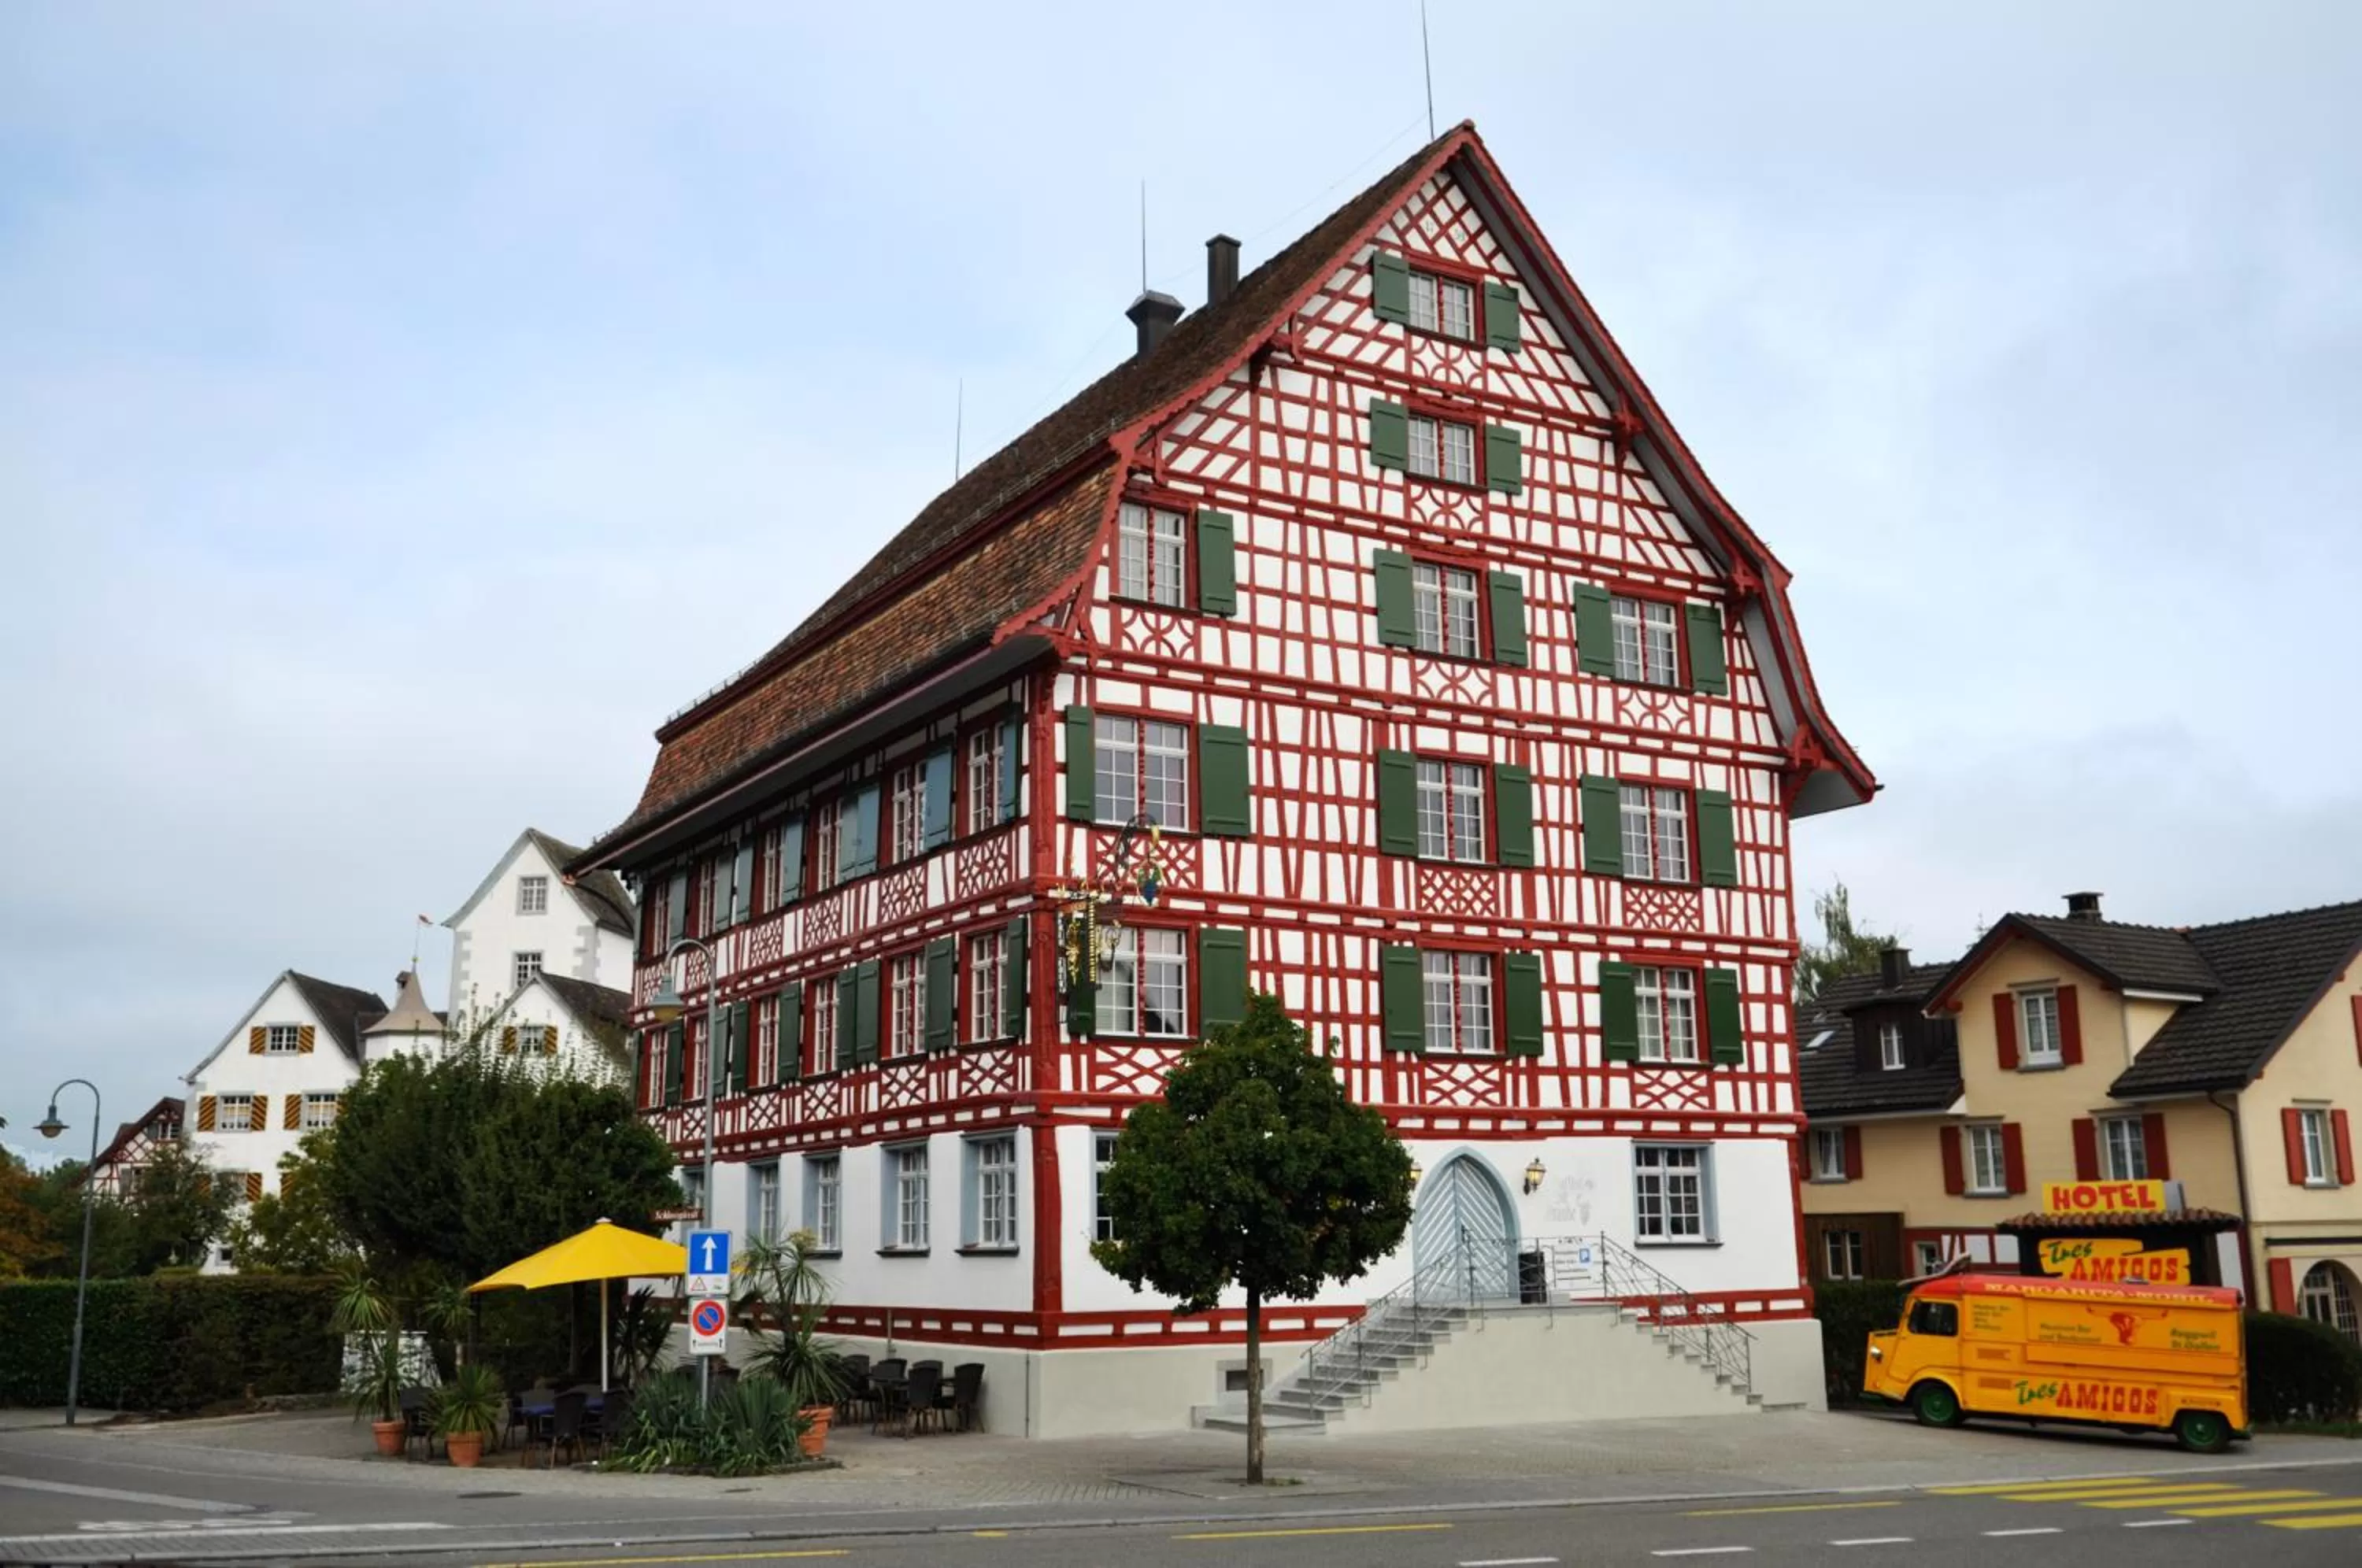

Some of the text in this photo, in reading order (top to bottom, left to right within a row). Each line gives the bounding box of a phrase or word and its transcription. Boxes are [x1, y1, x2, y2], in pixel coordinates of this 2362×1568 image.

[2052, 1184, 2157, 1211] HOTEL
[2046, 1241, 2094, 1264] Tres
[2070, 1257, 2179, 1281] AMIGOS
[2015, 1380, 2158, 1415] Tres AMIGOS
